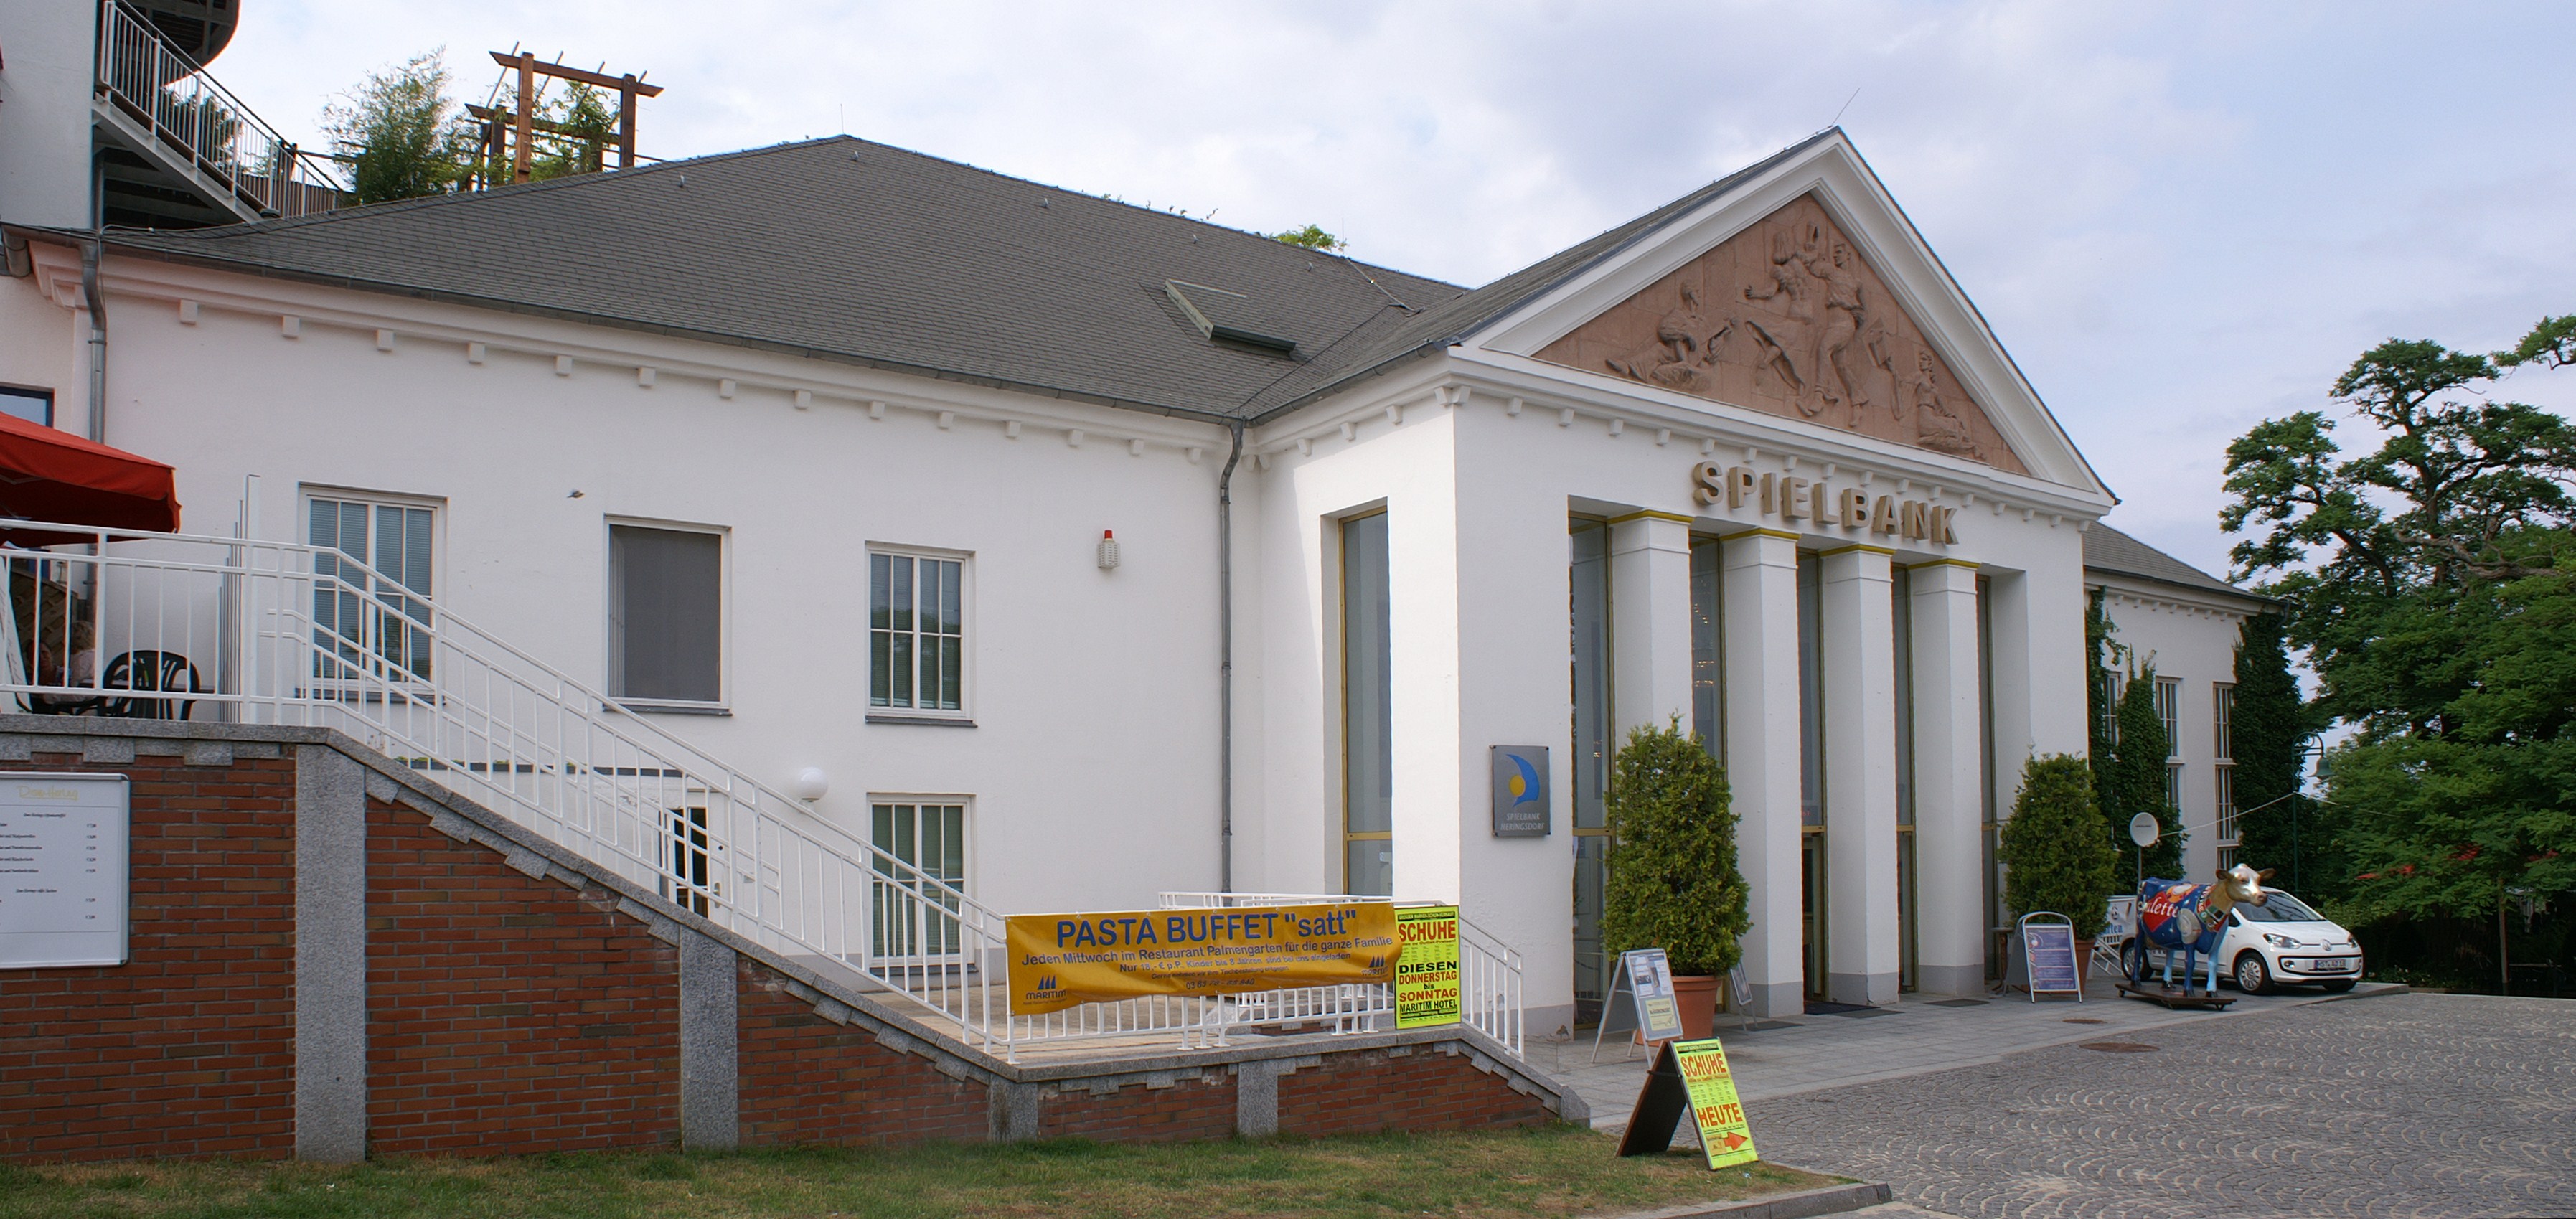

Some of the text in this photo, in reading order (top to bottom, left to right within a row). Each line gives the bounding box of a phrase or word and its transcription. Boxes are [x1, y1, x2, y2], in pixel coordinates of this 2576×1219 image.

[1693, 460, 1959, 545] SPIELBANK
[1500, 822, 1545, 831] HERINGSDORF
[1057, 910, 1356, 948] PASTA BUFFET "satt"
[1399, 921, 1456, 942] SCHUHE
[1022, 936, 1393, 966] Jeden Mittwoch im Restaurant Palmengarten für die ganze Familie
[1119, 964, 1137, 972] Nur
[1311, 953, 1350, 962] eingeladen
[1399, 961, 1457, 974] DIESEN
[1399, 971, 1457, 984] DONNERSTAG
[1399, 988, 1457, 1002] SONNTAG
[1400, 1000, 1432, 1012] MARITIM
[1434, 999, 1457, 1009] HOTEL
[1680, 1053, 1726, 1077] SCHUHE
[1696, 1103, 1743, 1128] HEUTE
